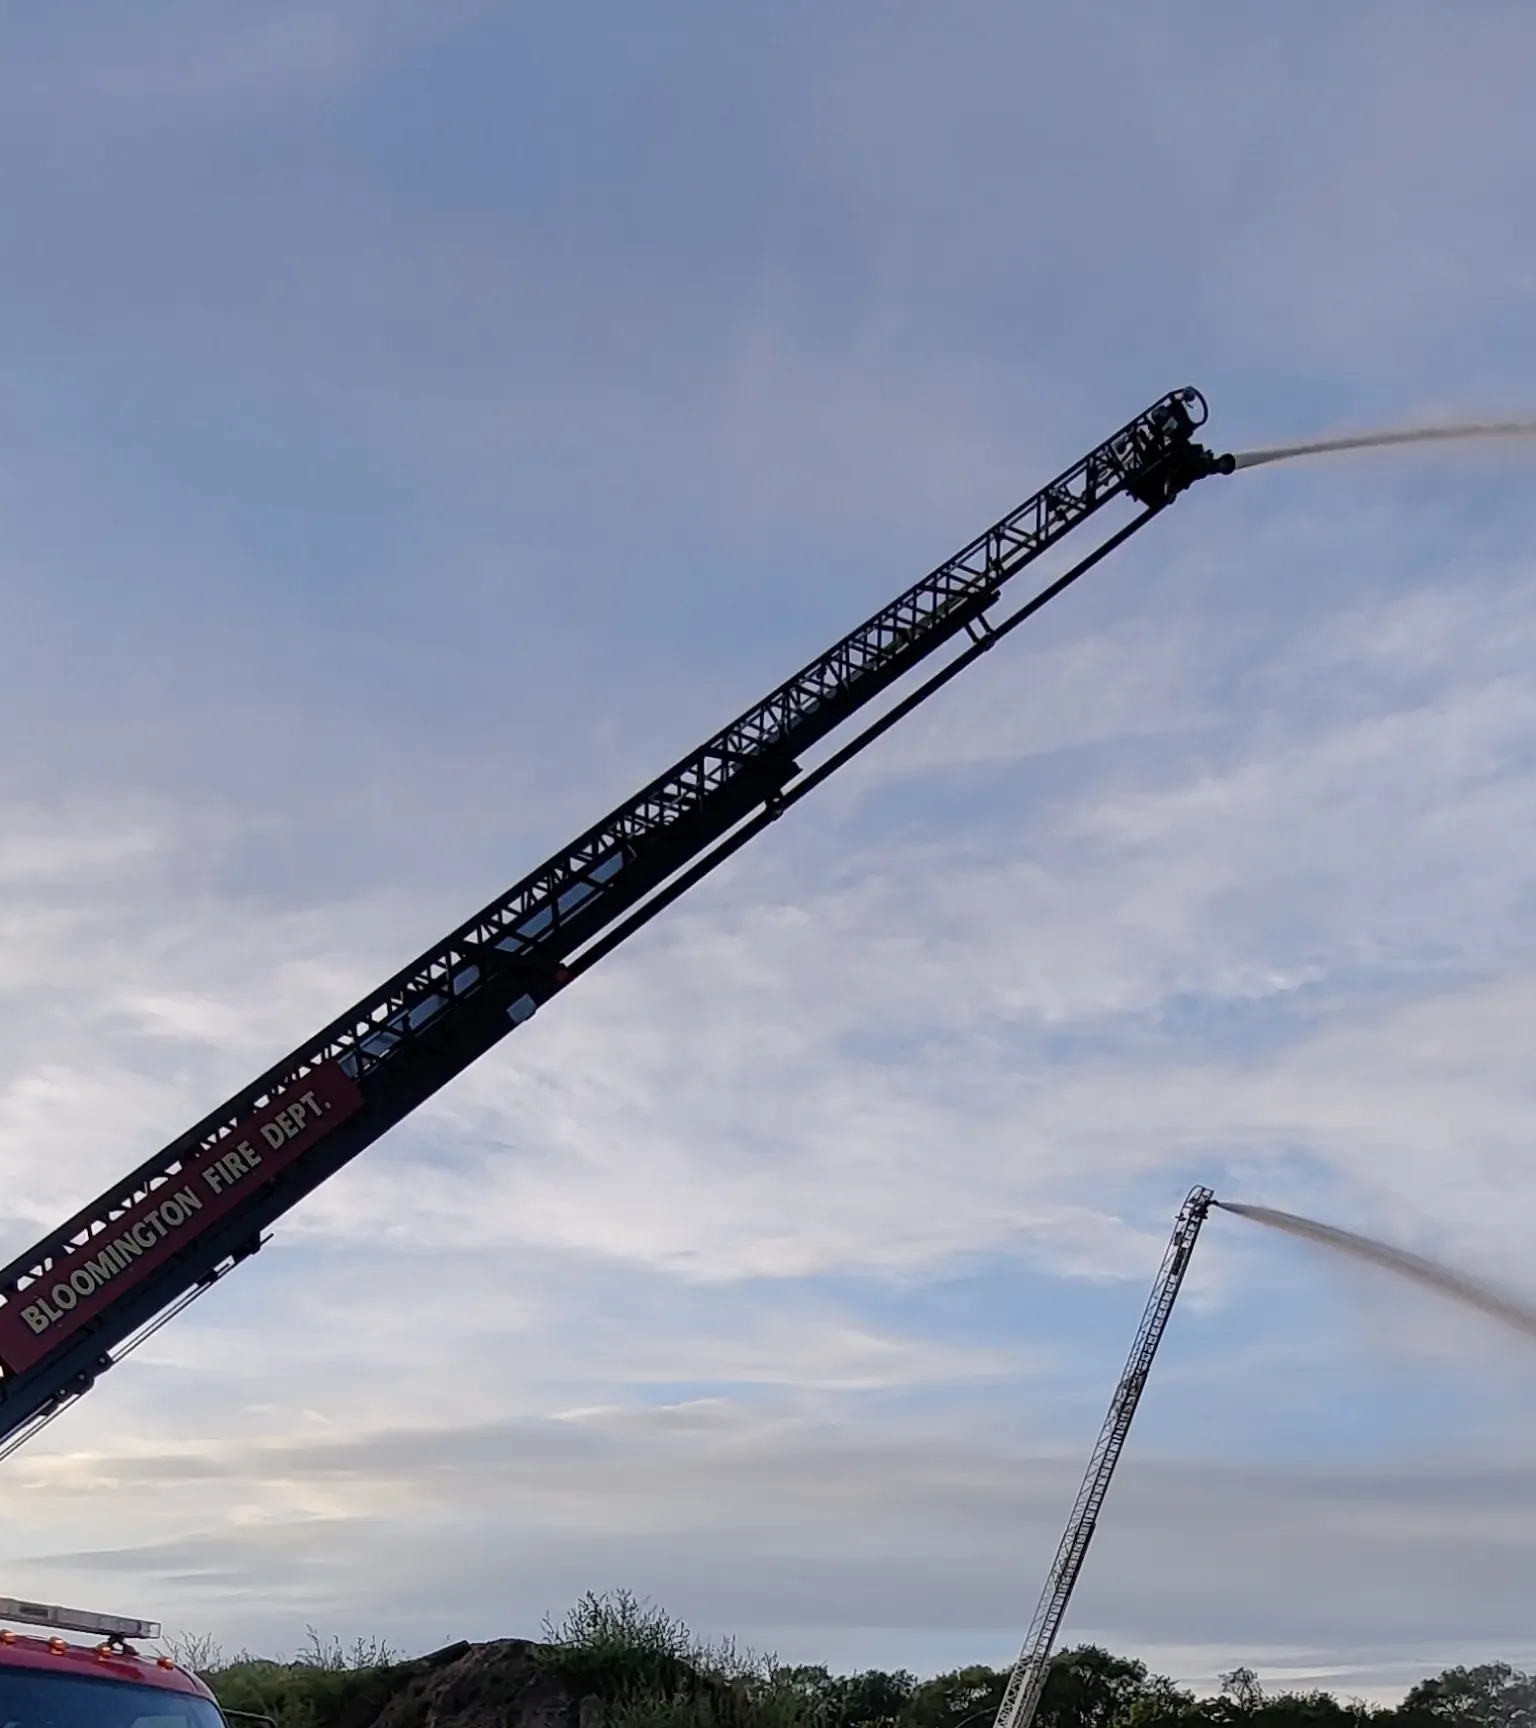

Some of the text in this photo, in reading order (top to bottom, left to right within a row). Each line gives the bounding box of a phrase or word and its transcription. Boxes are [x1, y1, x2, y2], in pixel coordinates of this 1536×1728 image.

[20, 1091, 332, 1334] BLOOMINGTON FIRE DEPT.
